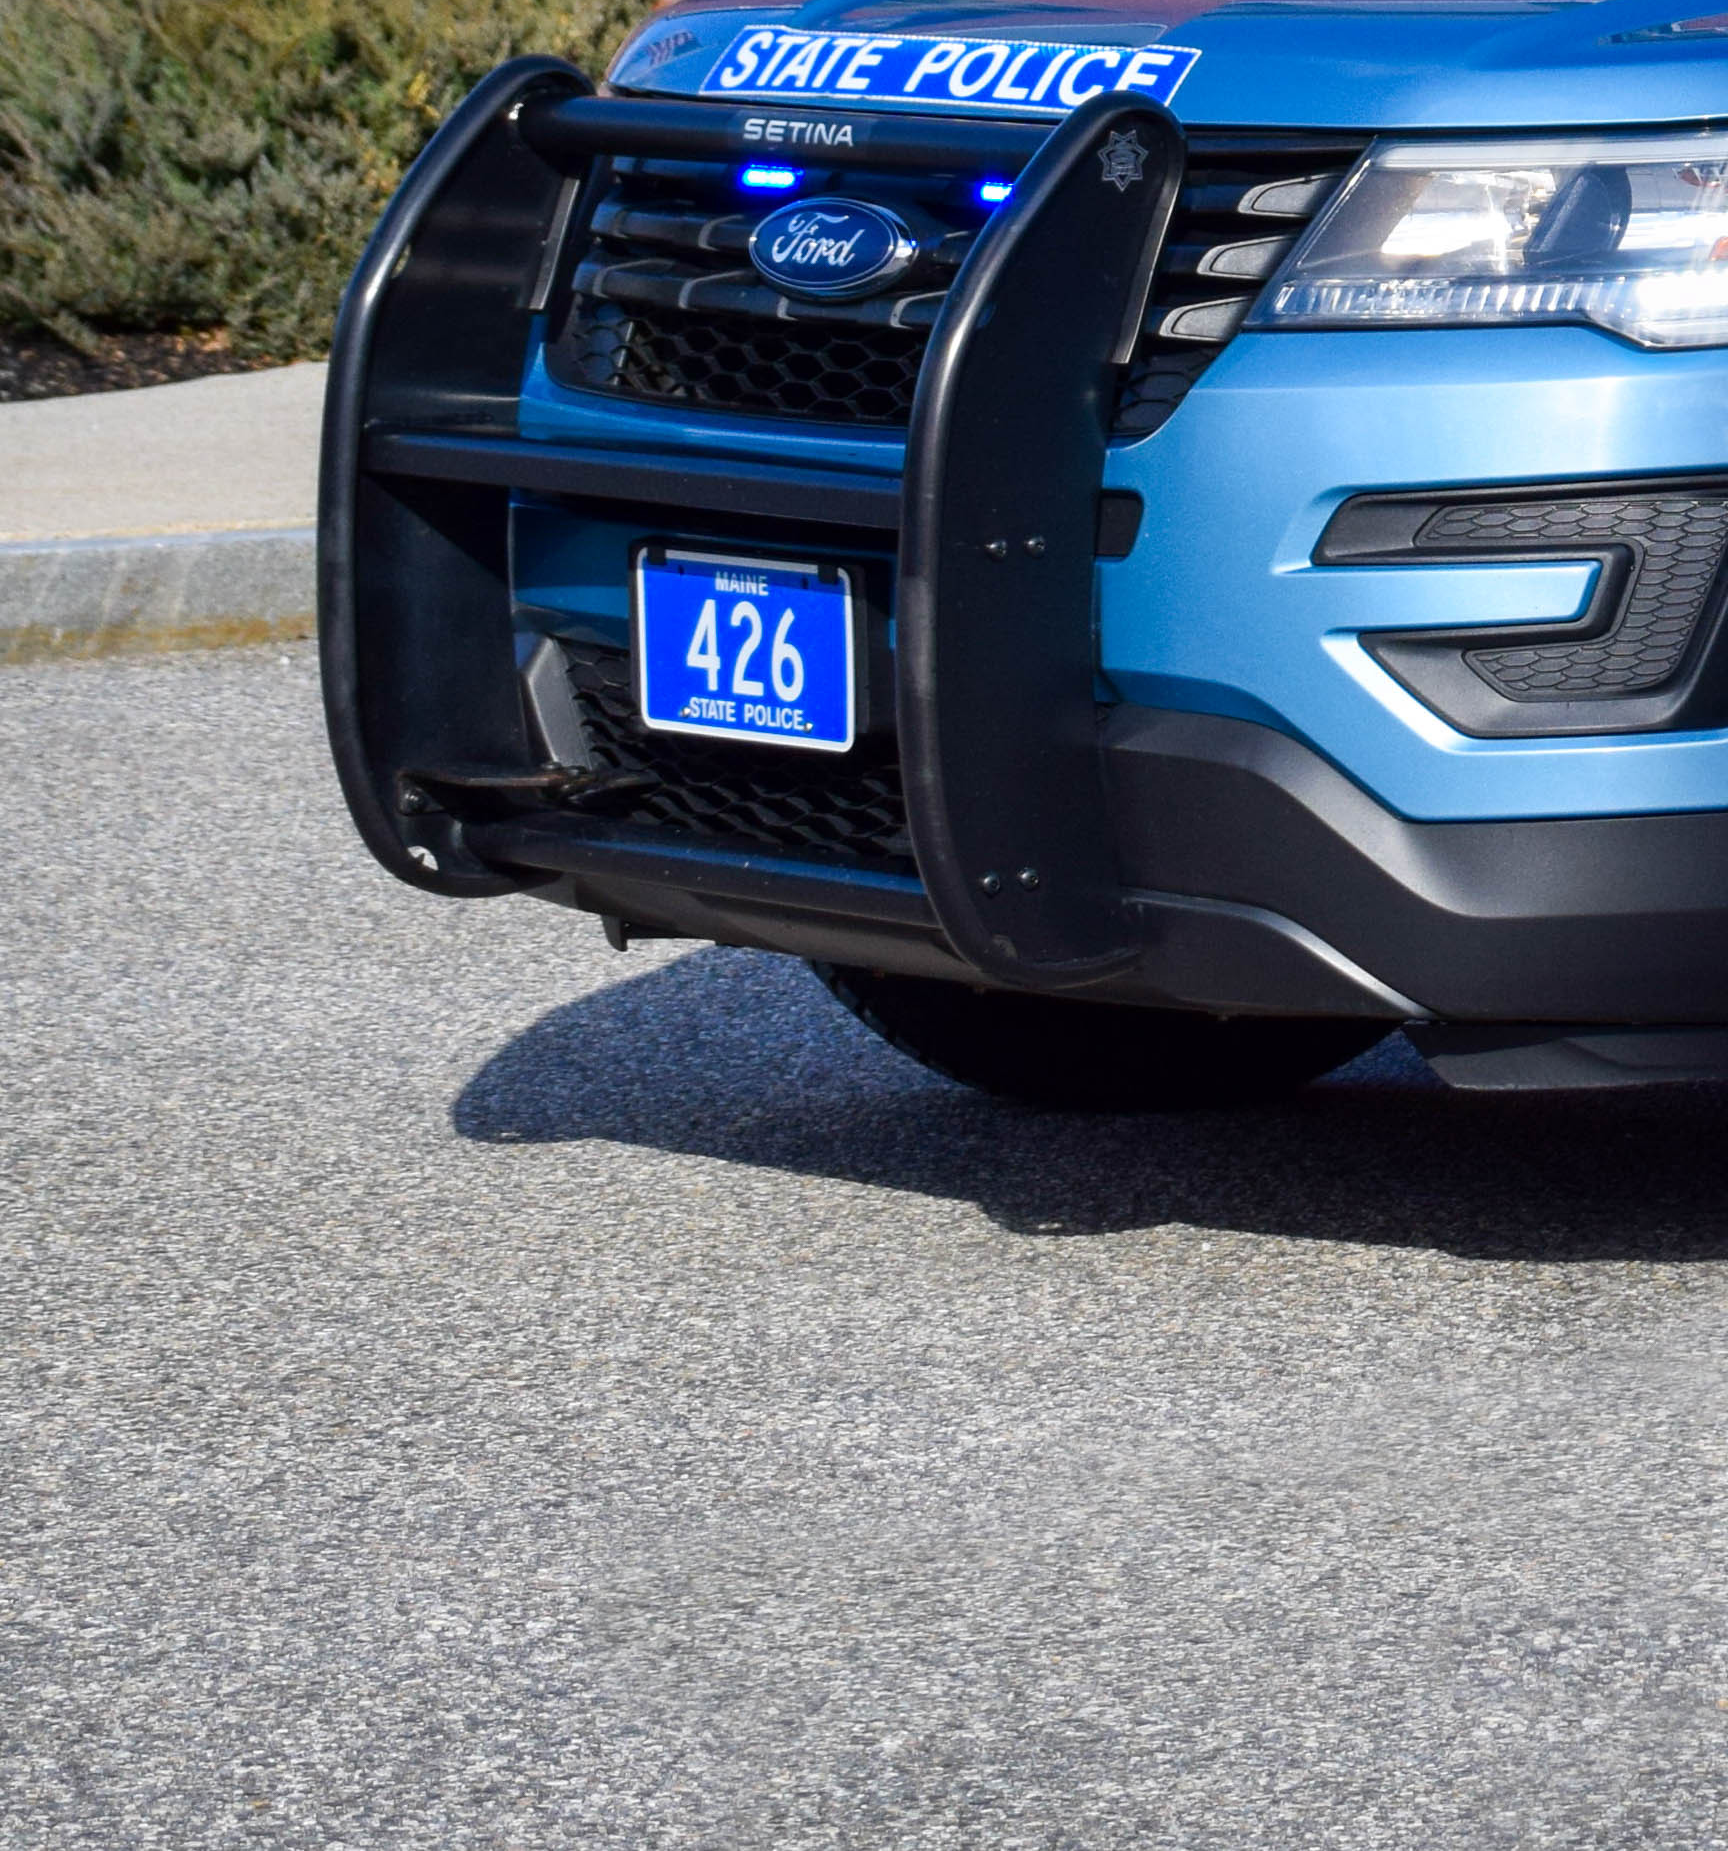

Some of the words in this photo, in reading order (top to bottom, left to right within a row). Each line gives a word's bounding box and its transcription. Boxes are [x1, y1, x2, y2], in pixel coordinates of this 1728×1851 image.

[720, 30, 902, 91] STATE
[903, 42, 1175, 106] POLICE
[743, 118, 854, 147] SETINA
[771, 211, 860, 267] Ford
[715, 571, 769, 596] MAINE
[686, 599, 804, 701] 426
[689, 696, 736, 722] STATE
[744, 703, 804, 730] POLICE
